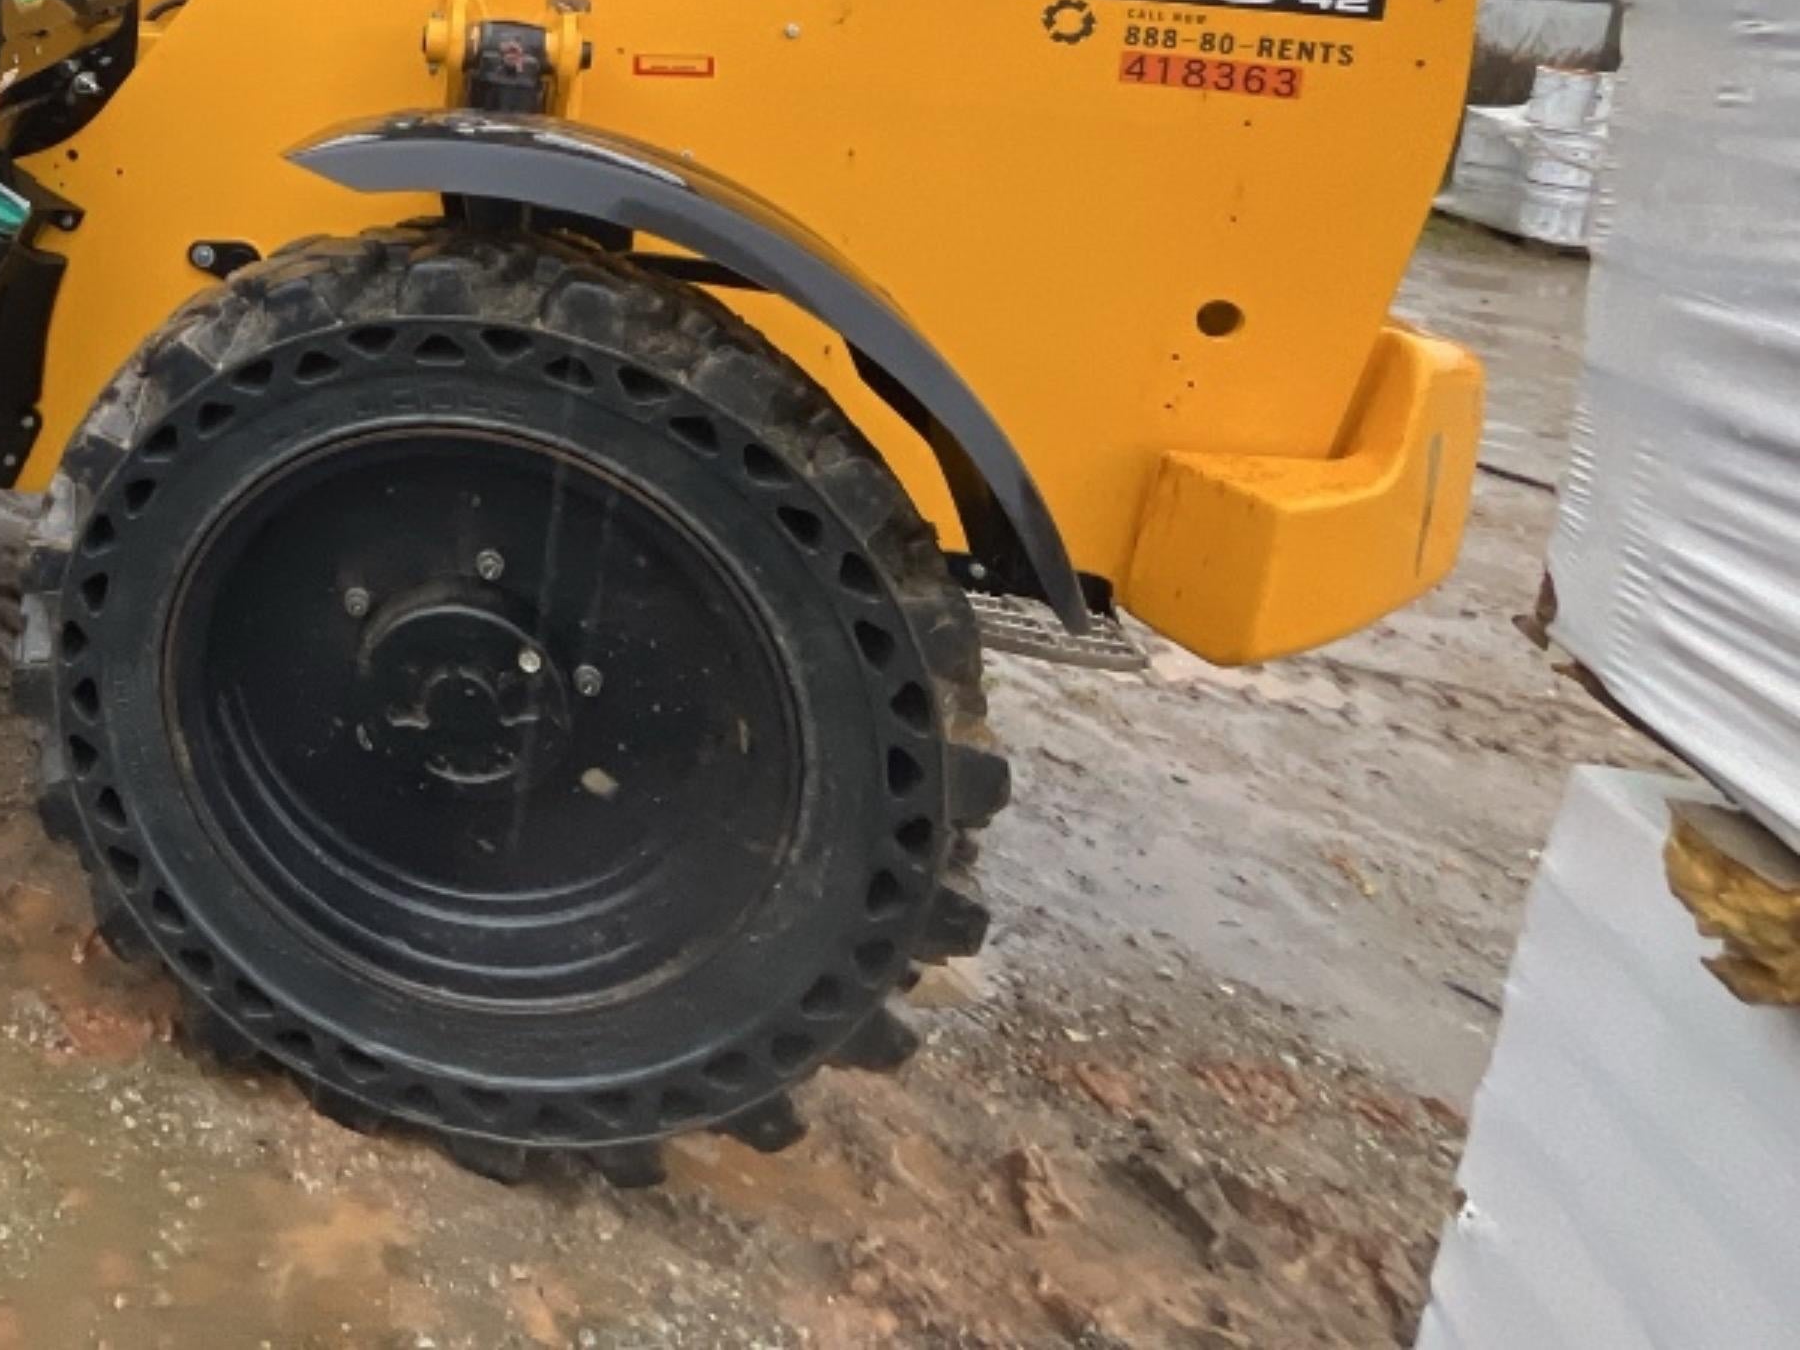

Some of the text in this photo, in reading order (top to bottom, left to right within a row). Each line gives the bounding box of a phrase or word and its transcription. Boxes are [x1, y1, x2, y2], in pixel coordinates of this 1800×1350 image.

[1127, 8, 1166, 22] CALL
[1124, 25, 1355, 66] 888-80-RENTS
[1124, 54, 1298, 99] 418363
